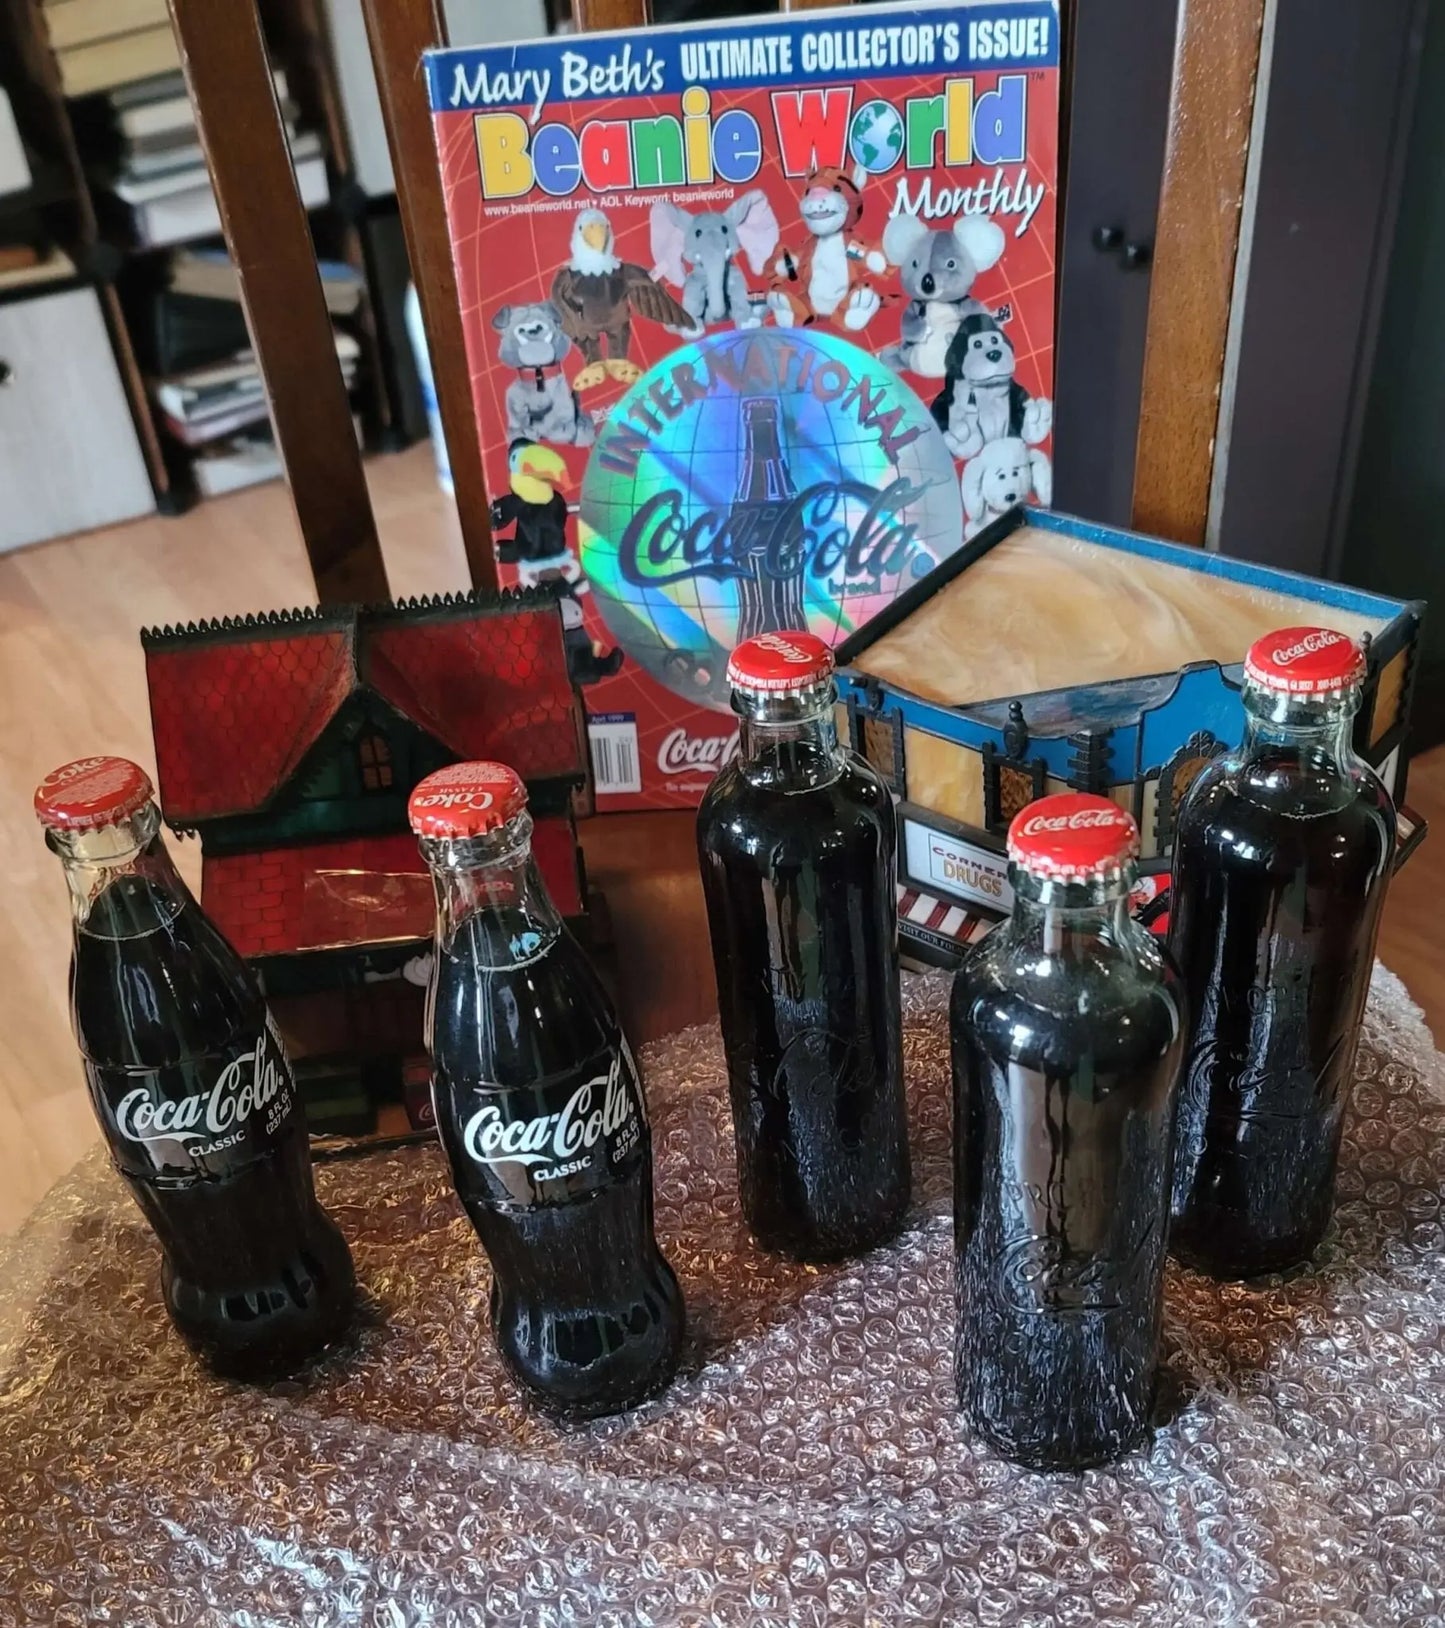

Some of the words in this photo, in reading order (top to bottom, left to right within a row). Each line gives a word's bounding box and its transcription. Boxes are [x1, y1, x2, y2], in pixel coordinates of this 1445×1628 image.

[680, 36, 793, 82] ULTIMATE
[801, 22, 960, 73] COLLECTOR'S
[968, 16, 1050, 61] ISSUE!
[450, 62, 551, 126] Mary
[560, 43, 666, 98] Beth's
[473, 86, 762, 201] Beanie
[770, 73, 1028, 179] World
[484, 198, 591, 217] www.beanieworld.net
[600, 197, 623, 208] AOL
[673, 187, 735, 203] beanieworld
[889, 167, 1045, 238] Monthly
[598, 343, 922, 477] INTERNATIONAL
[618, 476, 940, 589] Coca-Cola
[1272, 630, 1342, 667] Coca-Cola
[422, 792, 494, 810] Coke
[1023, 807, 1118, 836] Coca-Cola
[932, 846, 1007, 880] CORNER
[943, 860, 1003, 898] DRUGS
[116, 1028, 284, 1142] Coca-Cola
[464, 1050, 634, 1166] Coca-Cola
[189, 1129, 246, 1158] CLASSIC
[533, 1155, 592, 1182] CLASSIC
